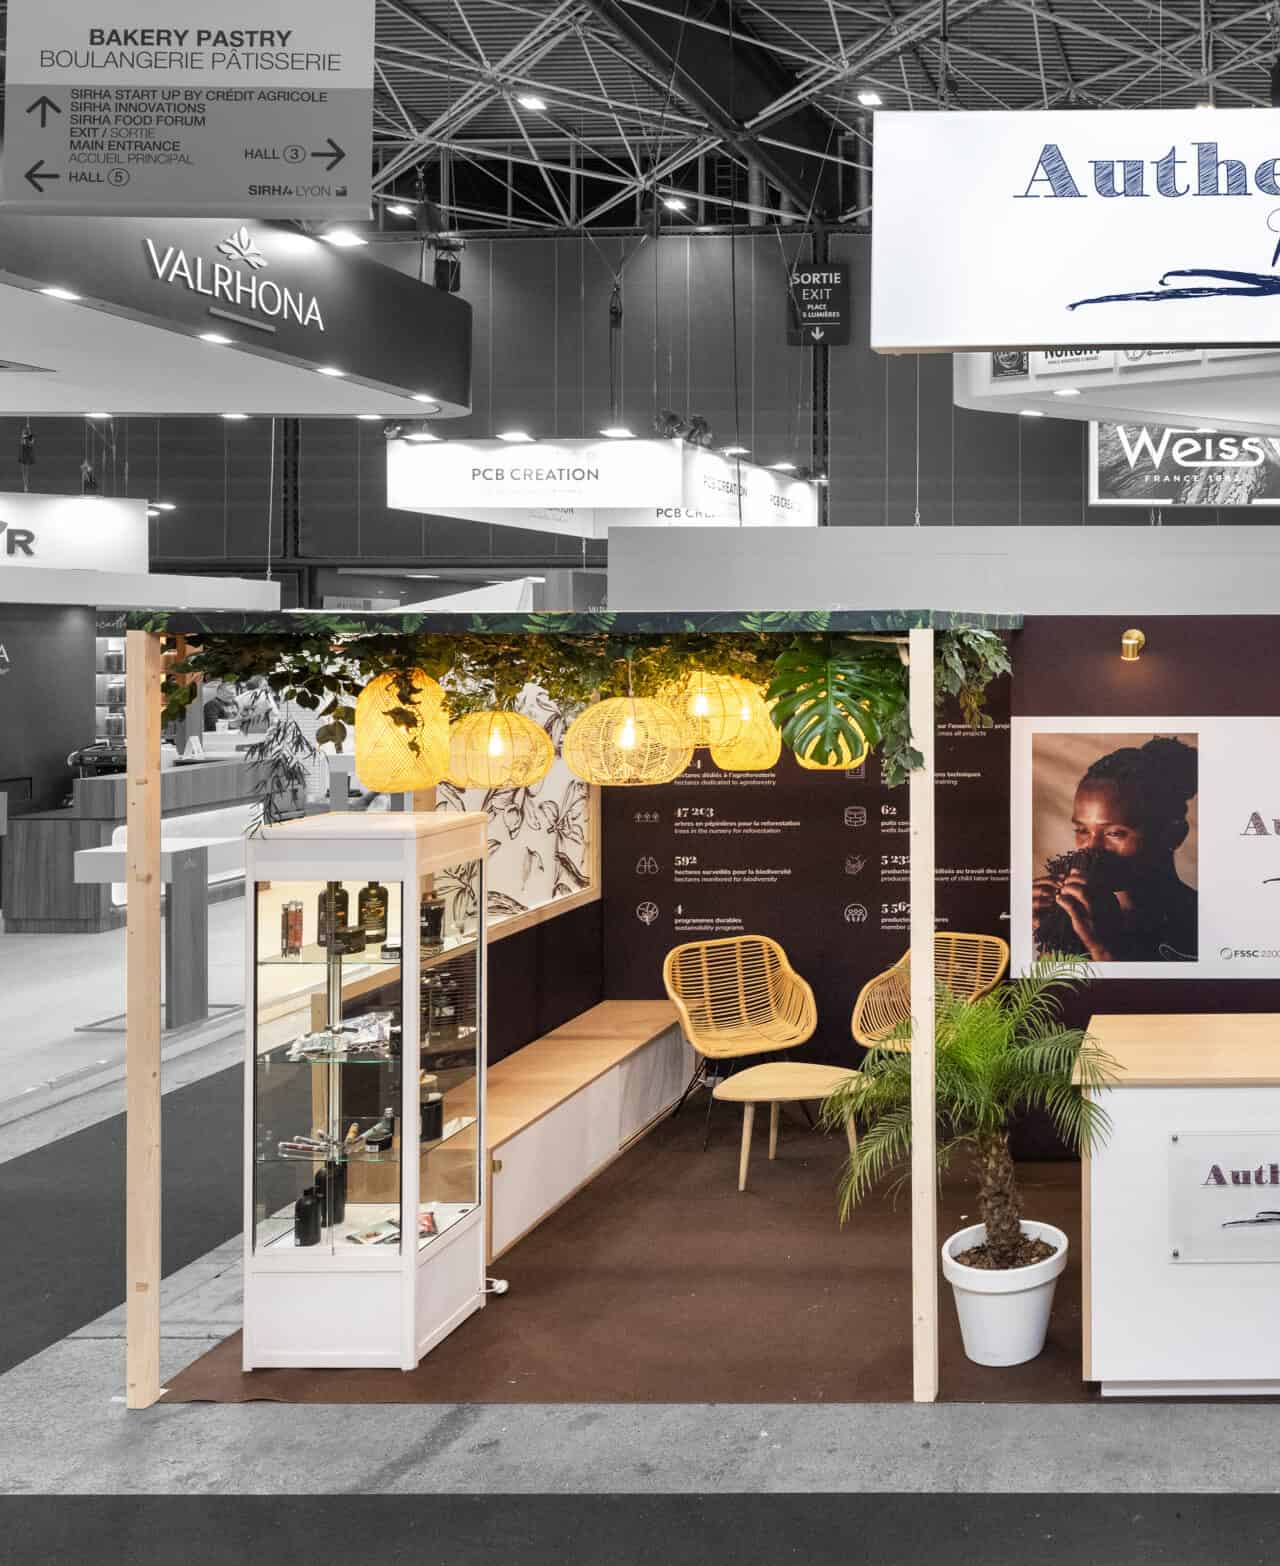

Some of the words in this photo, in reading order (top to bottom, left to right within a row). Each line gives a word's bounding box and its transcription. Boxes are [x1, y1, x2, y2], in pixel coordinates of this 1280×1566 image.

[89, 29, 188, 47] BAKERY
[196, 30, 292, 48] PASTRY
[40, 50, 204, 70] BOULANGERIE
[211, 49, 342, 72] PÂTISSERIE
[71, 88, 112, 100] SIRHA
[115, 89, 158, 100] START
[161, 90, 181, 101] UP
[184, 90, 202, 101] BY
[206, 88, 255, 101] CRÉDIT
[257, 90, 329, 103] AGRICOLE
[70, 101, 111, 113] SIRHA
[115, 102, 206, 114] INNOVATIONS
[70, 114, 111, 125] SIRHA
[115, 115, 153, 126] FOOD
[156, 115, 207, 127] FORUM
[70, 127, 99, 138] EXIT
[110, 127, 156, 139] SORTIE
[70, 140, 104, 151] MAIN
[108, 140, 181, 152] ENTRANCE
[69, 152, 124, 164] ACCUEIL
[127, 153, 195, 166] PRINCIPAL
[244, 147, 281, 160] HALL
[69, 171, 105, 183] HALL
[296, 185, 332, 197] LYON
[145, 237, 326, 332] VALRHONA
[791, 272, 841, 285] SORTIE
[802, 288, 833, 300] EXIT
[472, 468, 505, 481] PCB
[510, 468, 600, 481] CREATION
[1143, 474, 1202, 483] FRANCE
[656, 508, 683, 519] PCB
[881, 804, 897, 815] 62
[674, 856, 698, 866] 592
[1234, 950, 1260, 958] FSSC
